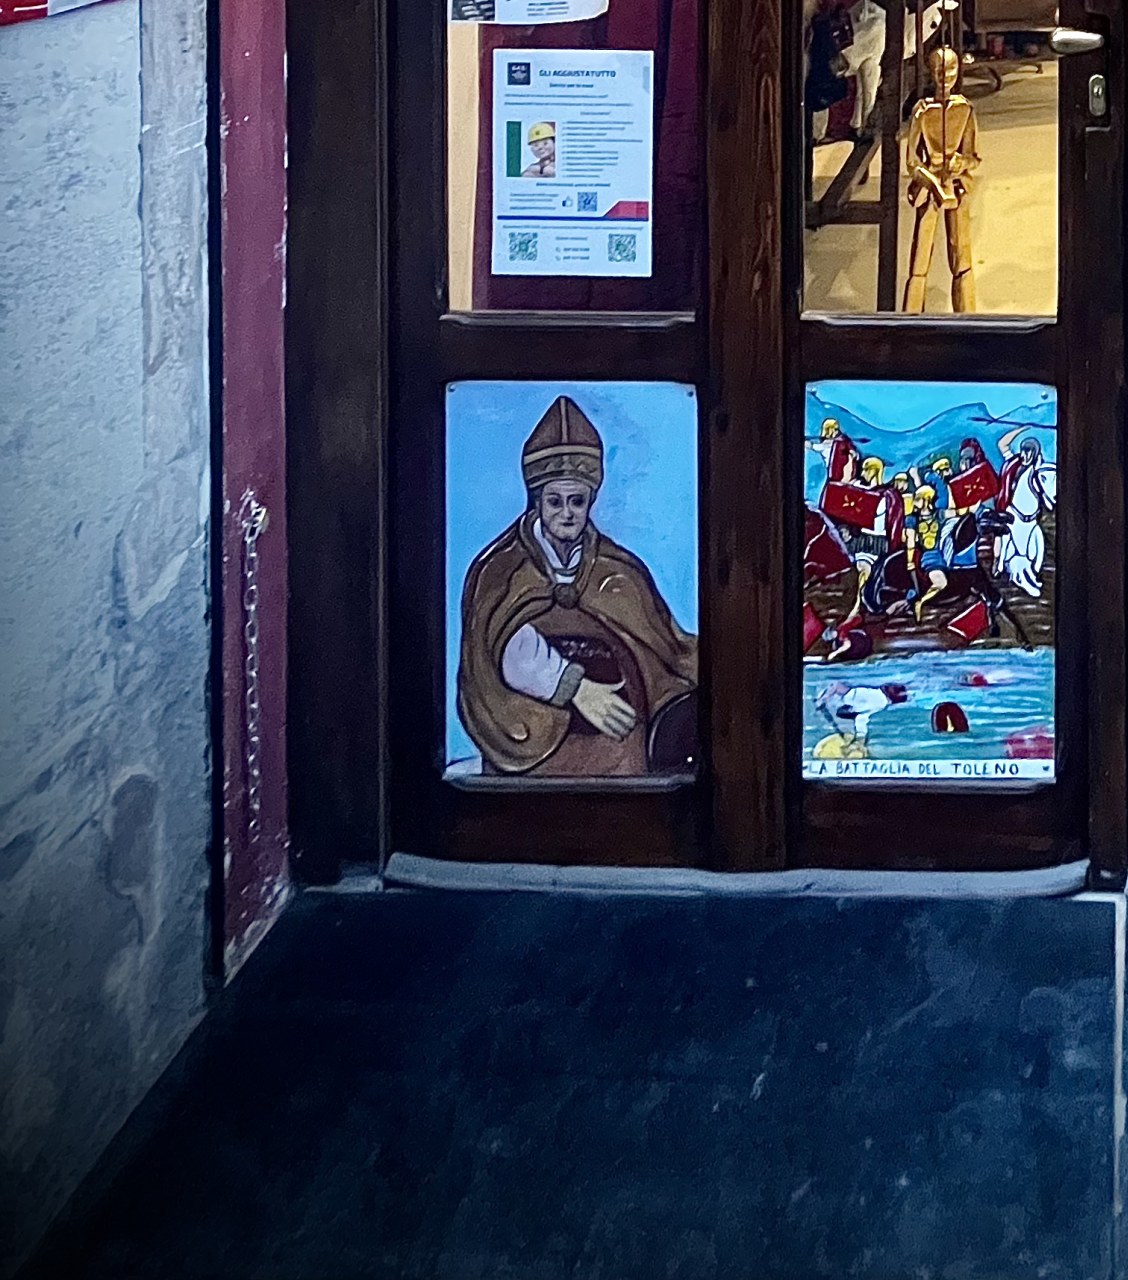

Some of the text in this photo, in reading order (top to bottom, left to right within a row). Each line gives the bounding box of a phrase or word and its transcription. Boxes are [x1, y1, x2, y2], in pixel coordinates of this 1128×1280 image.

[836, 761, 911, 775] BATTAGLIA
[918, 762, 941, 775] DEL
[953, 762, 1020, 775] TOLENO
